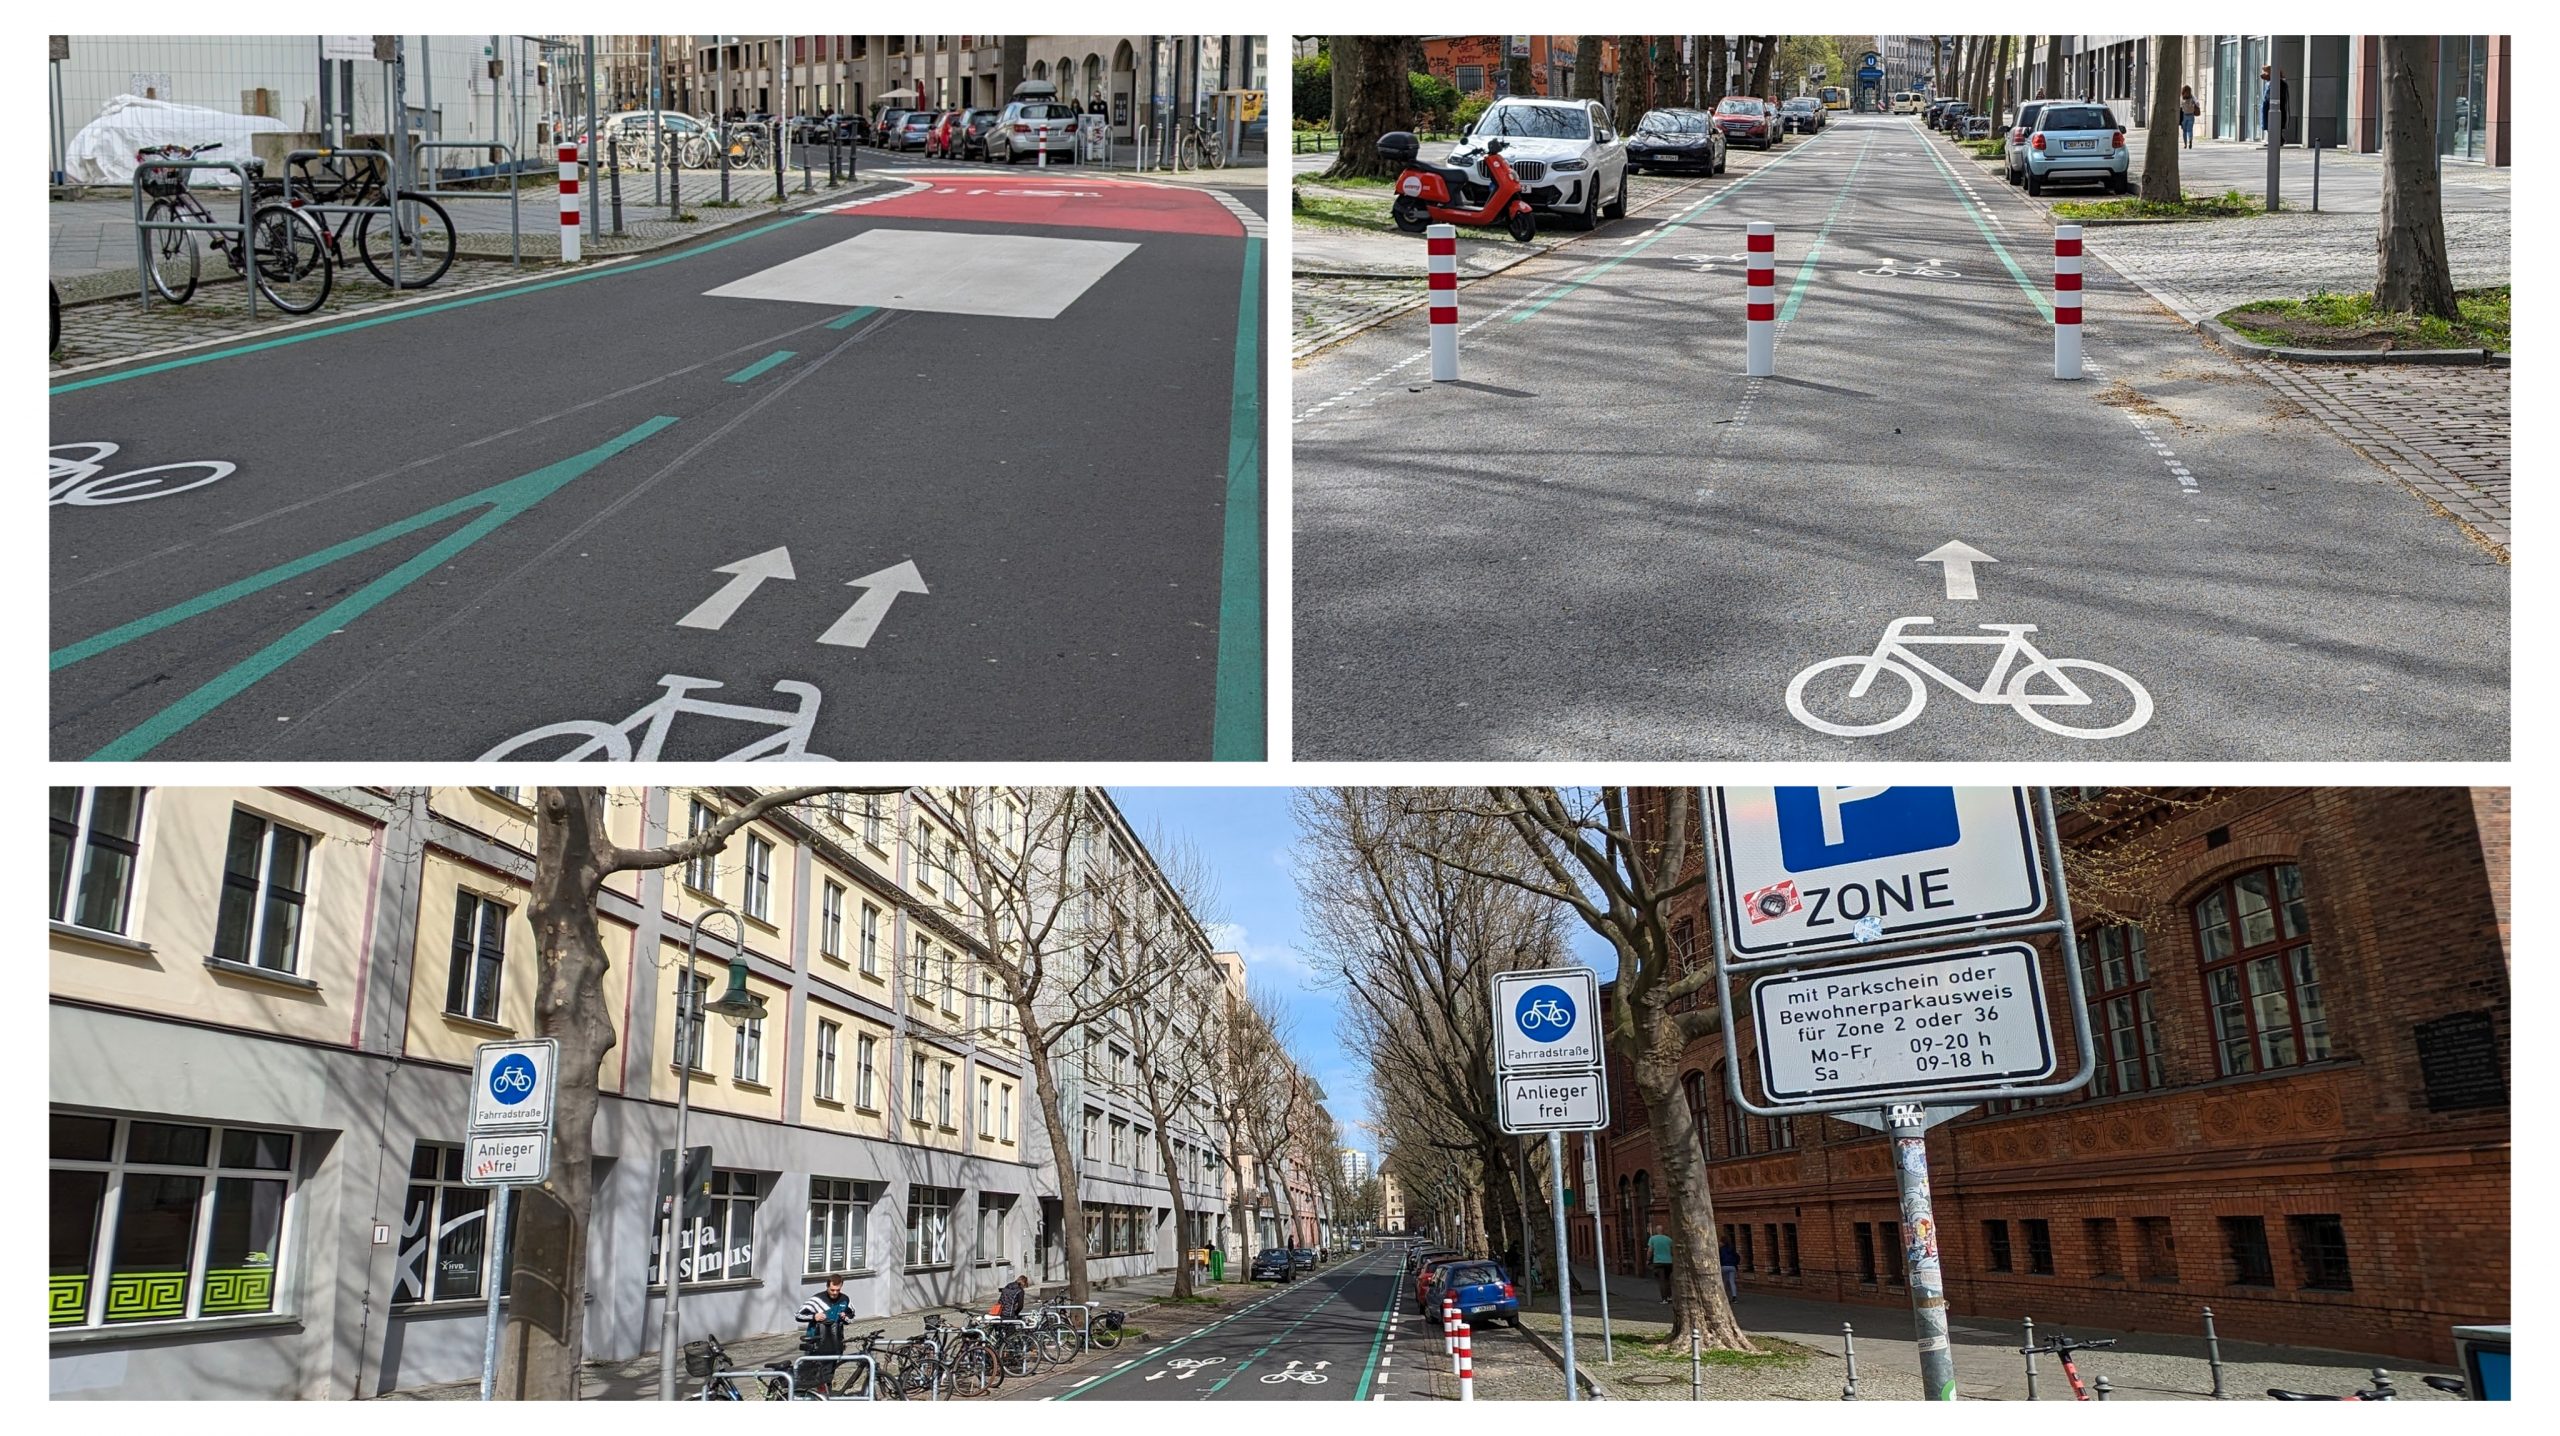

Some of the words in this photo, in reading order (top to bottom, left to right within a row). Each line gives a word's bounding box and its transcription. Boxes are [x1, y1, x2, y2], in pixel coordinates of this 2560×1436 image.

[1803, 868, 1954, 927] ZONE
[1788, 988, 1819, 1004] mit
[1827, 973, 1938, 999] Parkschein
[1949, 967, 1996, 984] oder
[1780, 984, 2013, 1025] Bewohnerparkausweis
[1799, 1027, 1826, 1042] für
[1836, 1022, 1884, 1038] Zone
[1894, 1016, 1906, 1032] 2
[1916, 1012, 1963, 1029] oder
[1974, 1005, 1999, 1022] 36
[1508, 1046, 1589, 1060] Fahrradstraße
[1811, 1044, 1872, 1064] Mo-Fr
[1910, 1033, 1969, 1053] 09-20
[1978, 1031, 1991, 1046] h
[1814, 1066, 1839, 1081] Sa
[1916, 1052, 1972, 1071] 09-18
[1981, 1050, 1994, 1065] h
[1516, 1084, 1588, 1102] Anlieger
[479, 1108, 541, 1120] Fahrradstraße
[1539, 1103, 1568, 1118] frei
[478, 1143, 535, 1157] Anlieger
[494, 1159, 517, 1172] frei
